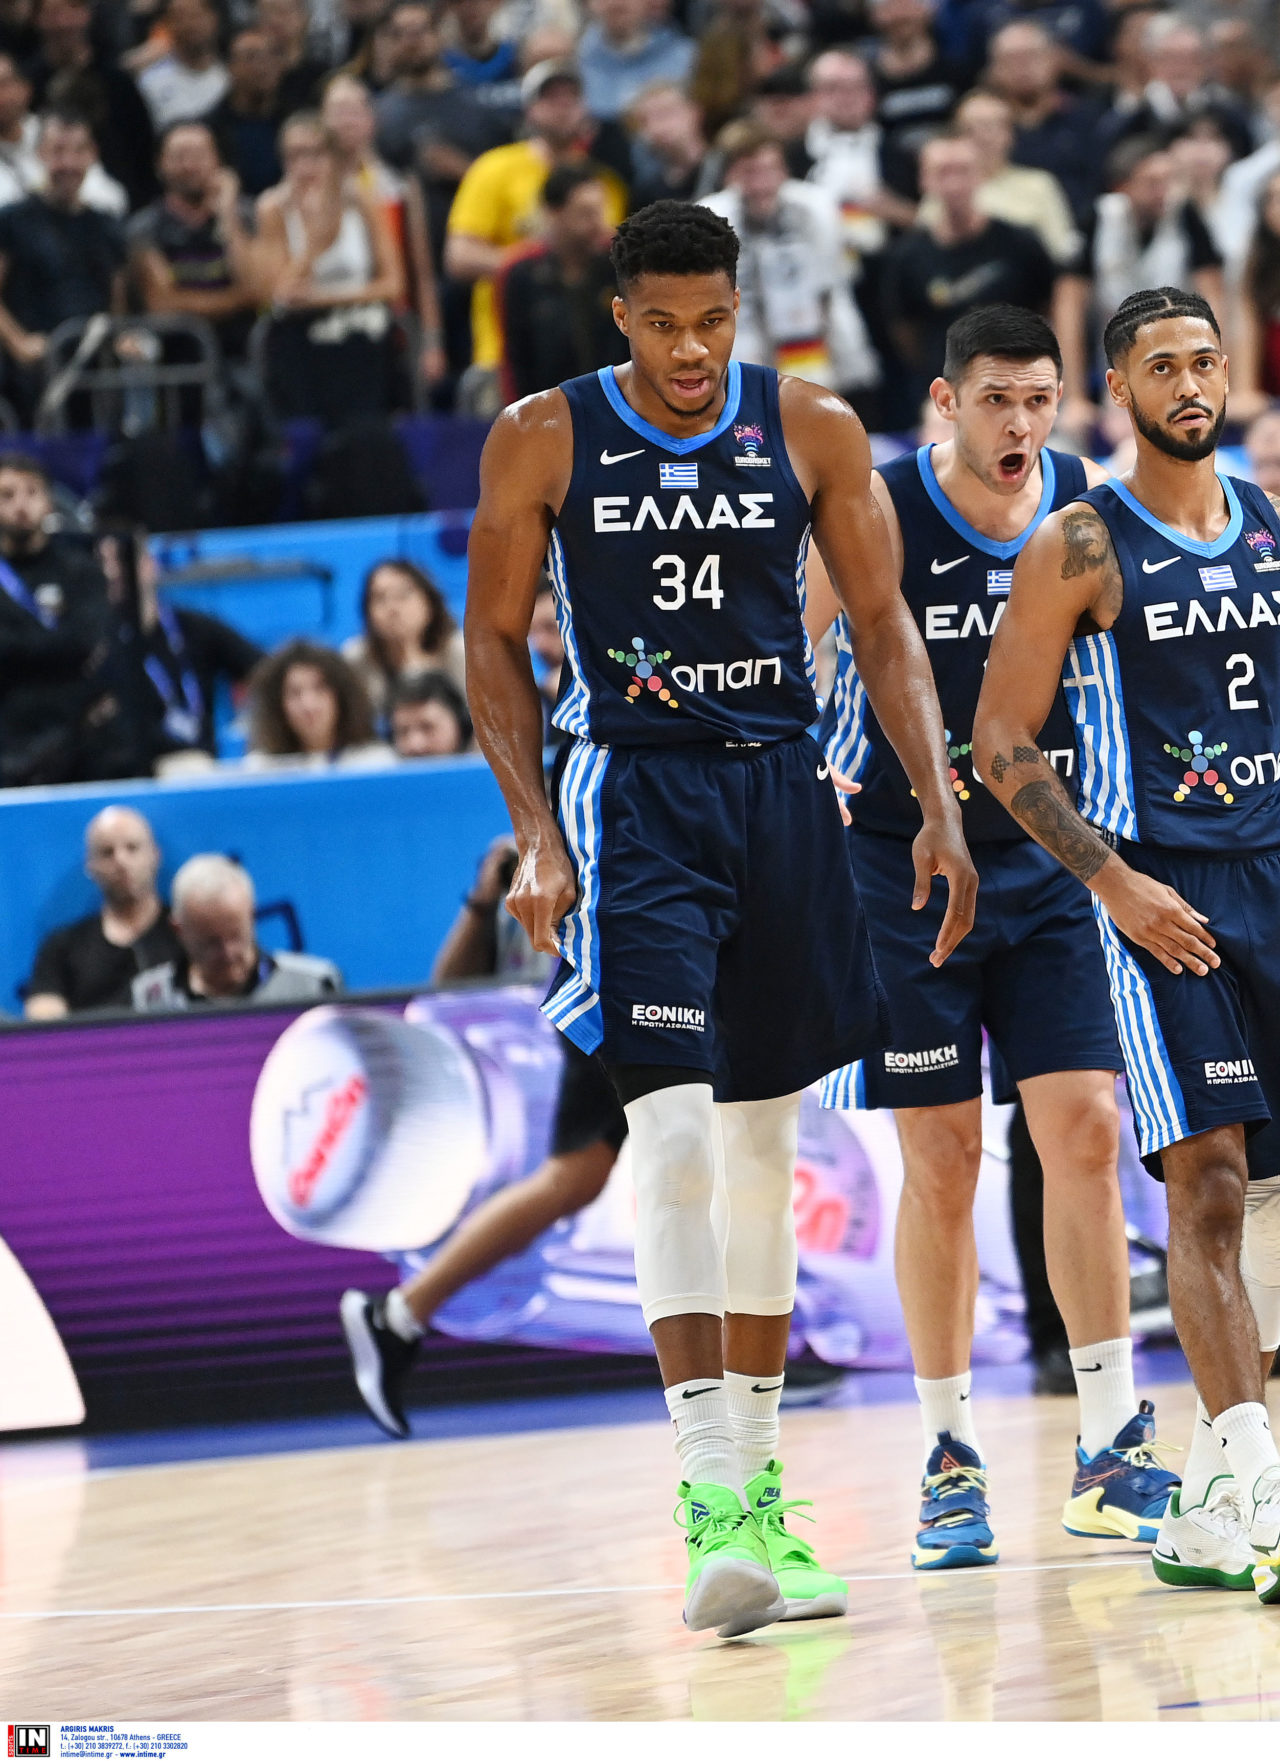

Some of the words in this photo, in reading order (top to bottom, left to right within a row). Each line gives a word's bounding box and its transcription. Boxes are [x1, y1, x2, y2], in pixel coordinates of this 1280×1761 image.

[594, 493, 775, 532] ΕΛΛΑΣ
[652, 554, 724, 611] 34
[1225, 653, 1260, 711] 2
